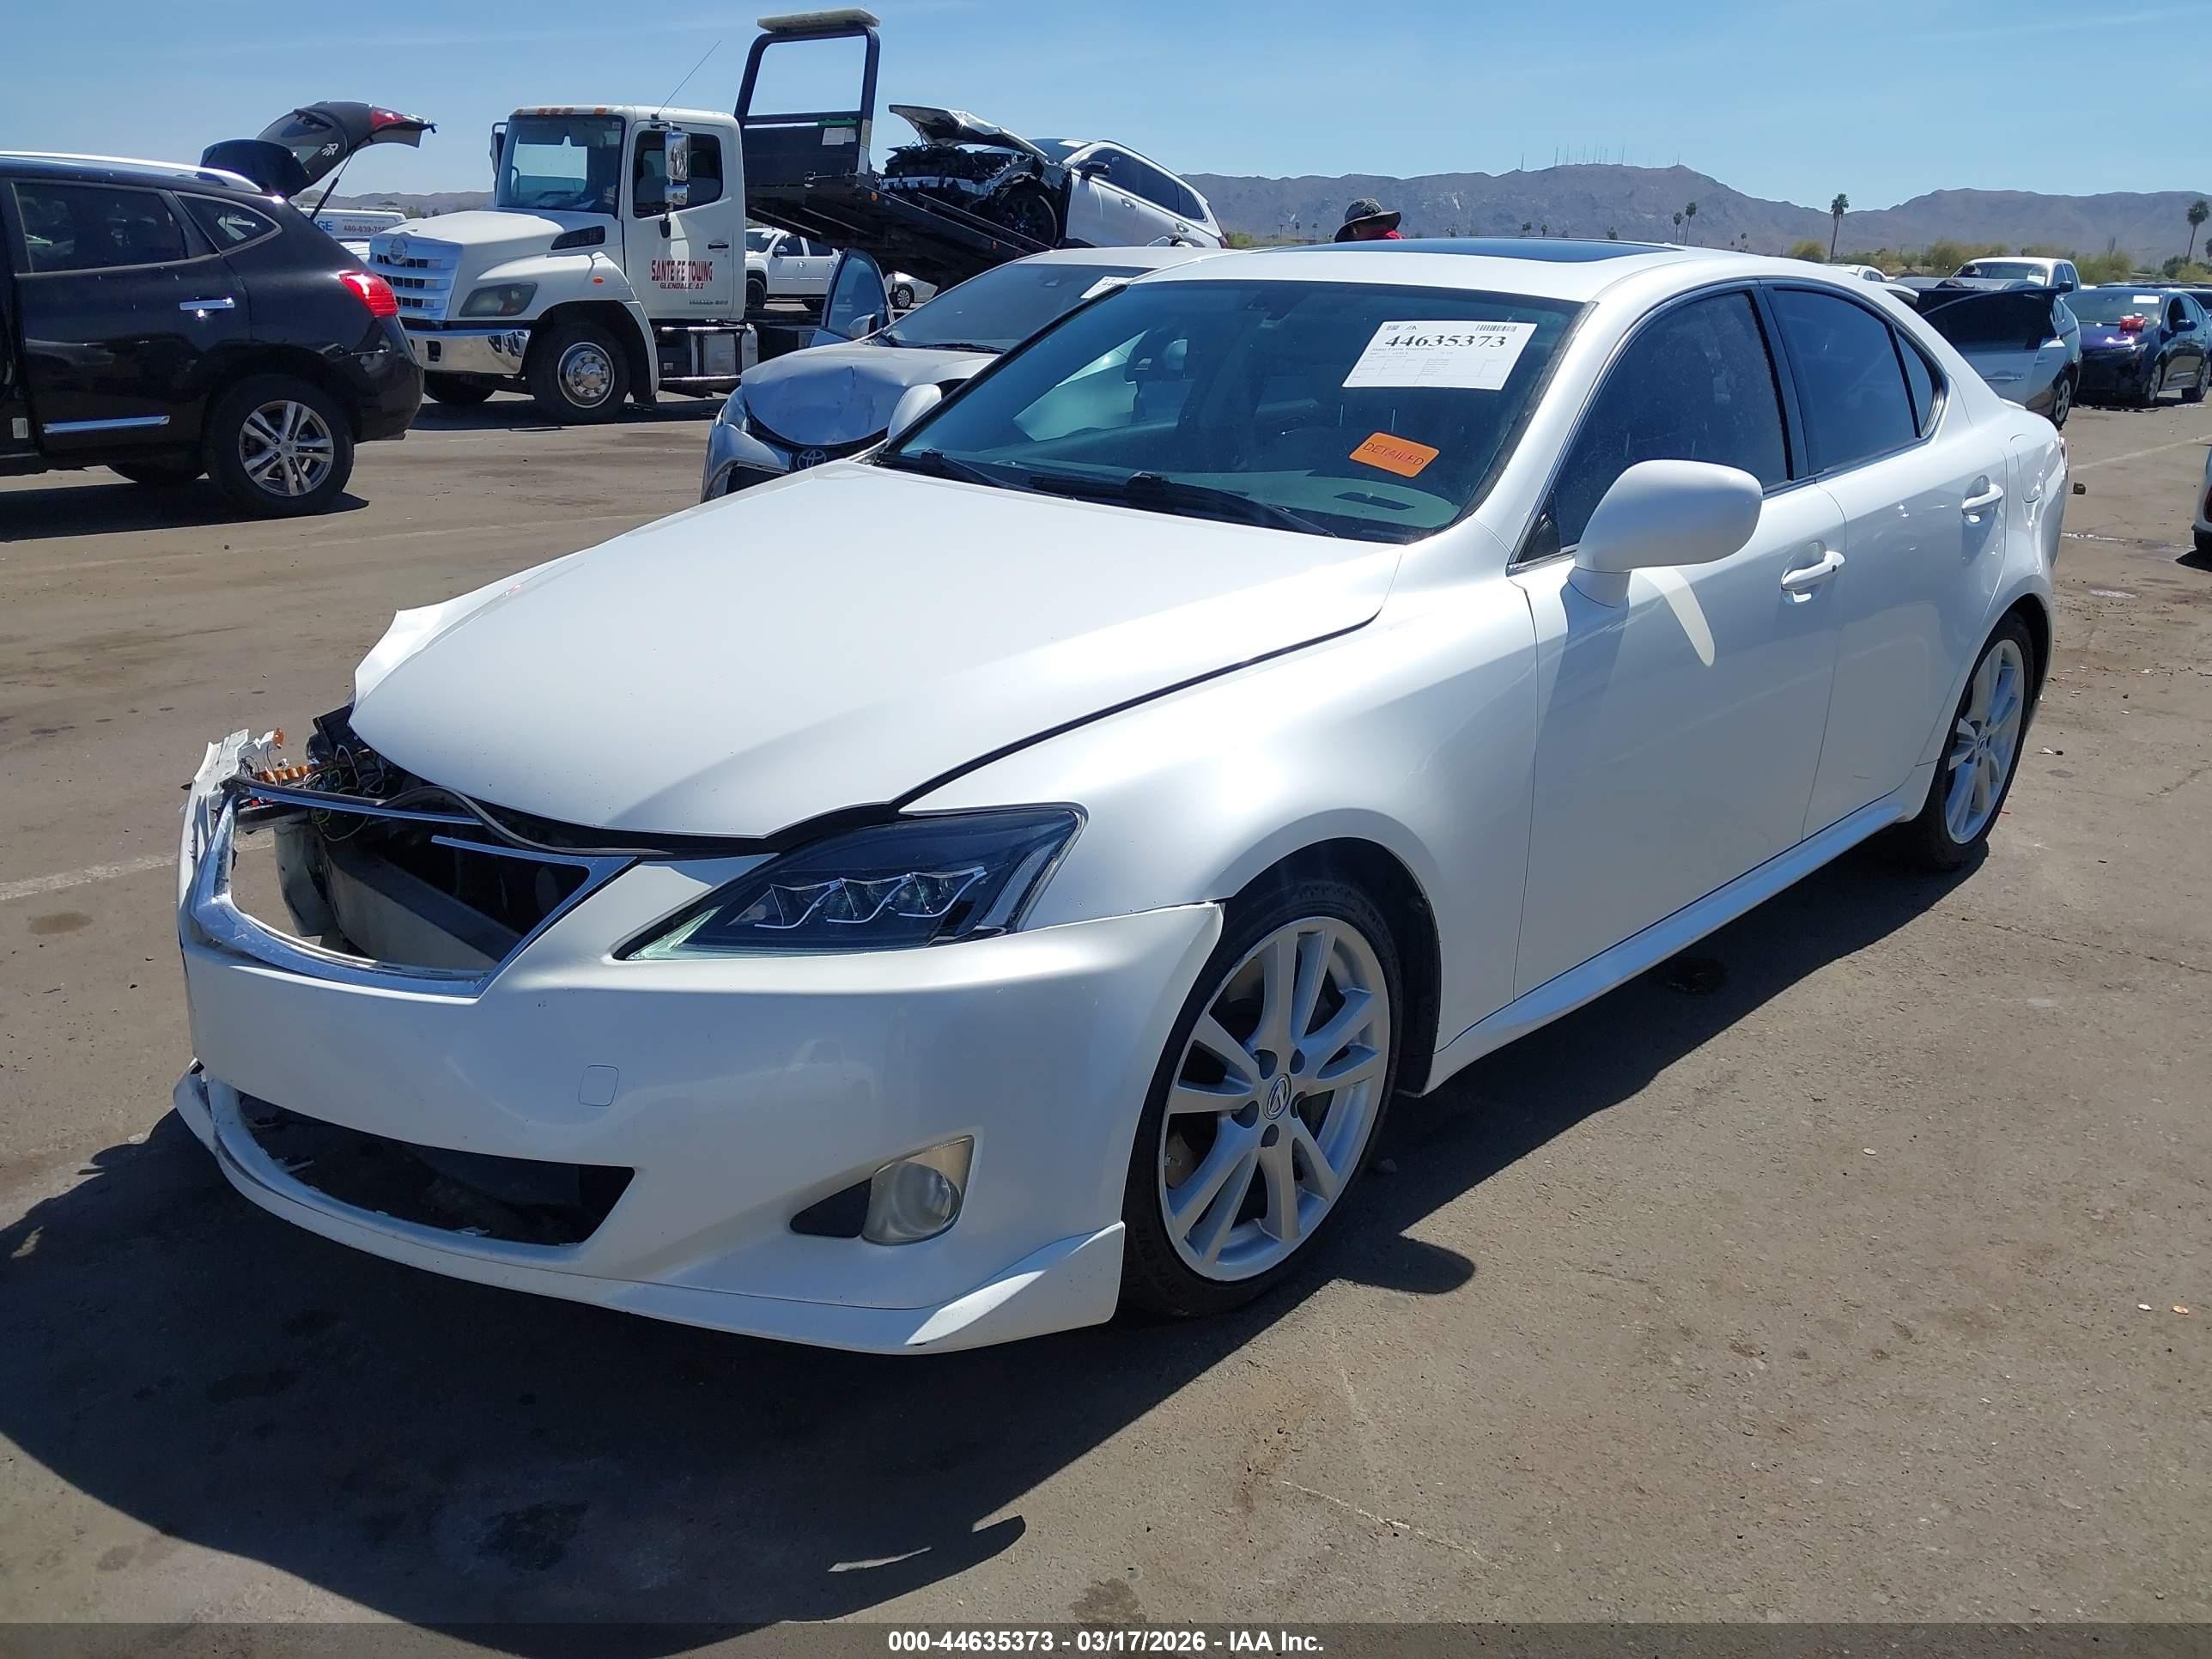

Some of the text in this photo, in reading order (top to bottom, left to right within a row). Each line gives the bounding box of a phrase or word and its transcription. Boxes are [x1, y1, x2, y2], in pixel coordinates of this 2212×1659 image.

[652, 260, 713, 282] SANTE FE TOWING
[1385, 335, 1507, 348] 44635373
